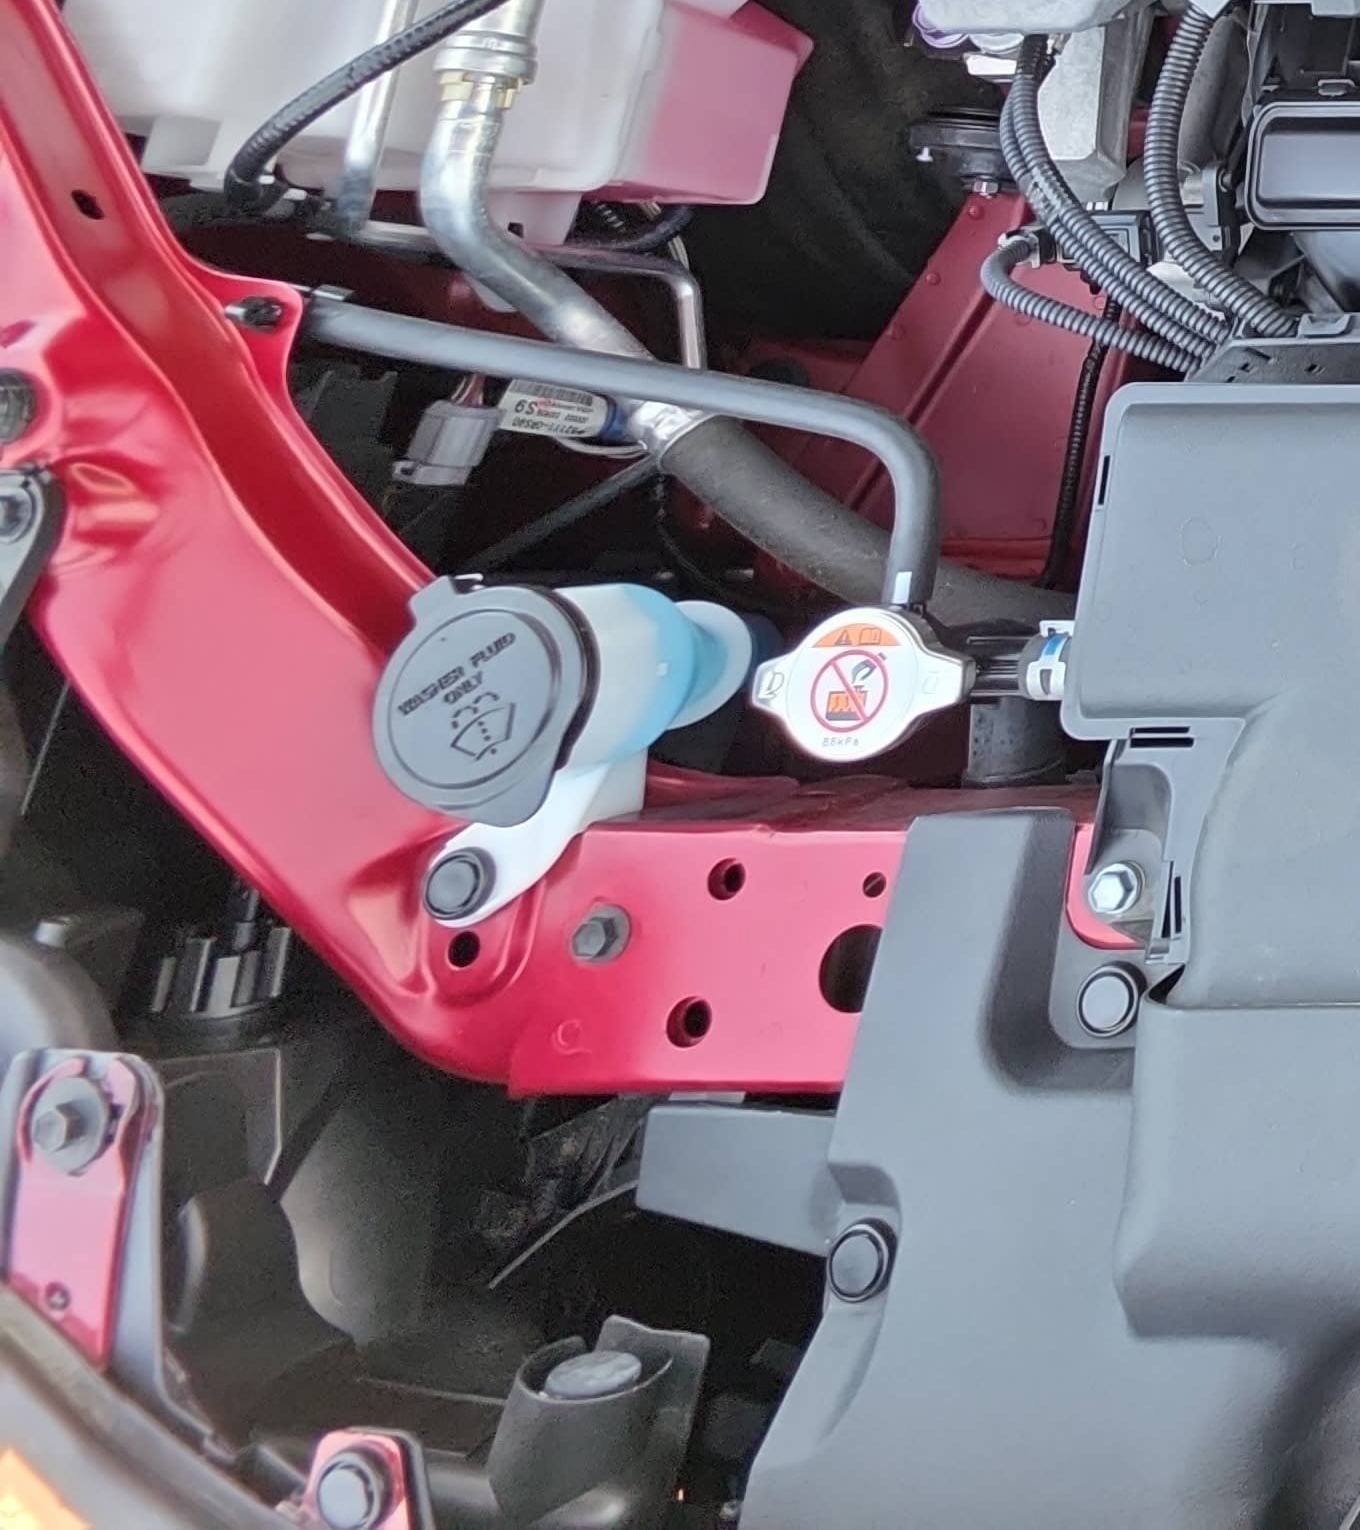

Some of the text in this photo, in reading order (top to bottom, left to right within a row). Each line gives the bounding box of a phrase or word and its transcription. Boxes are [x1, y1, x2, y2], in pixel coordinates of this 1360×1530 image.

[398, 632, 517, 716] WASHER FLUID
[443, 670, 483, 705] ONLY
